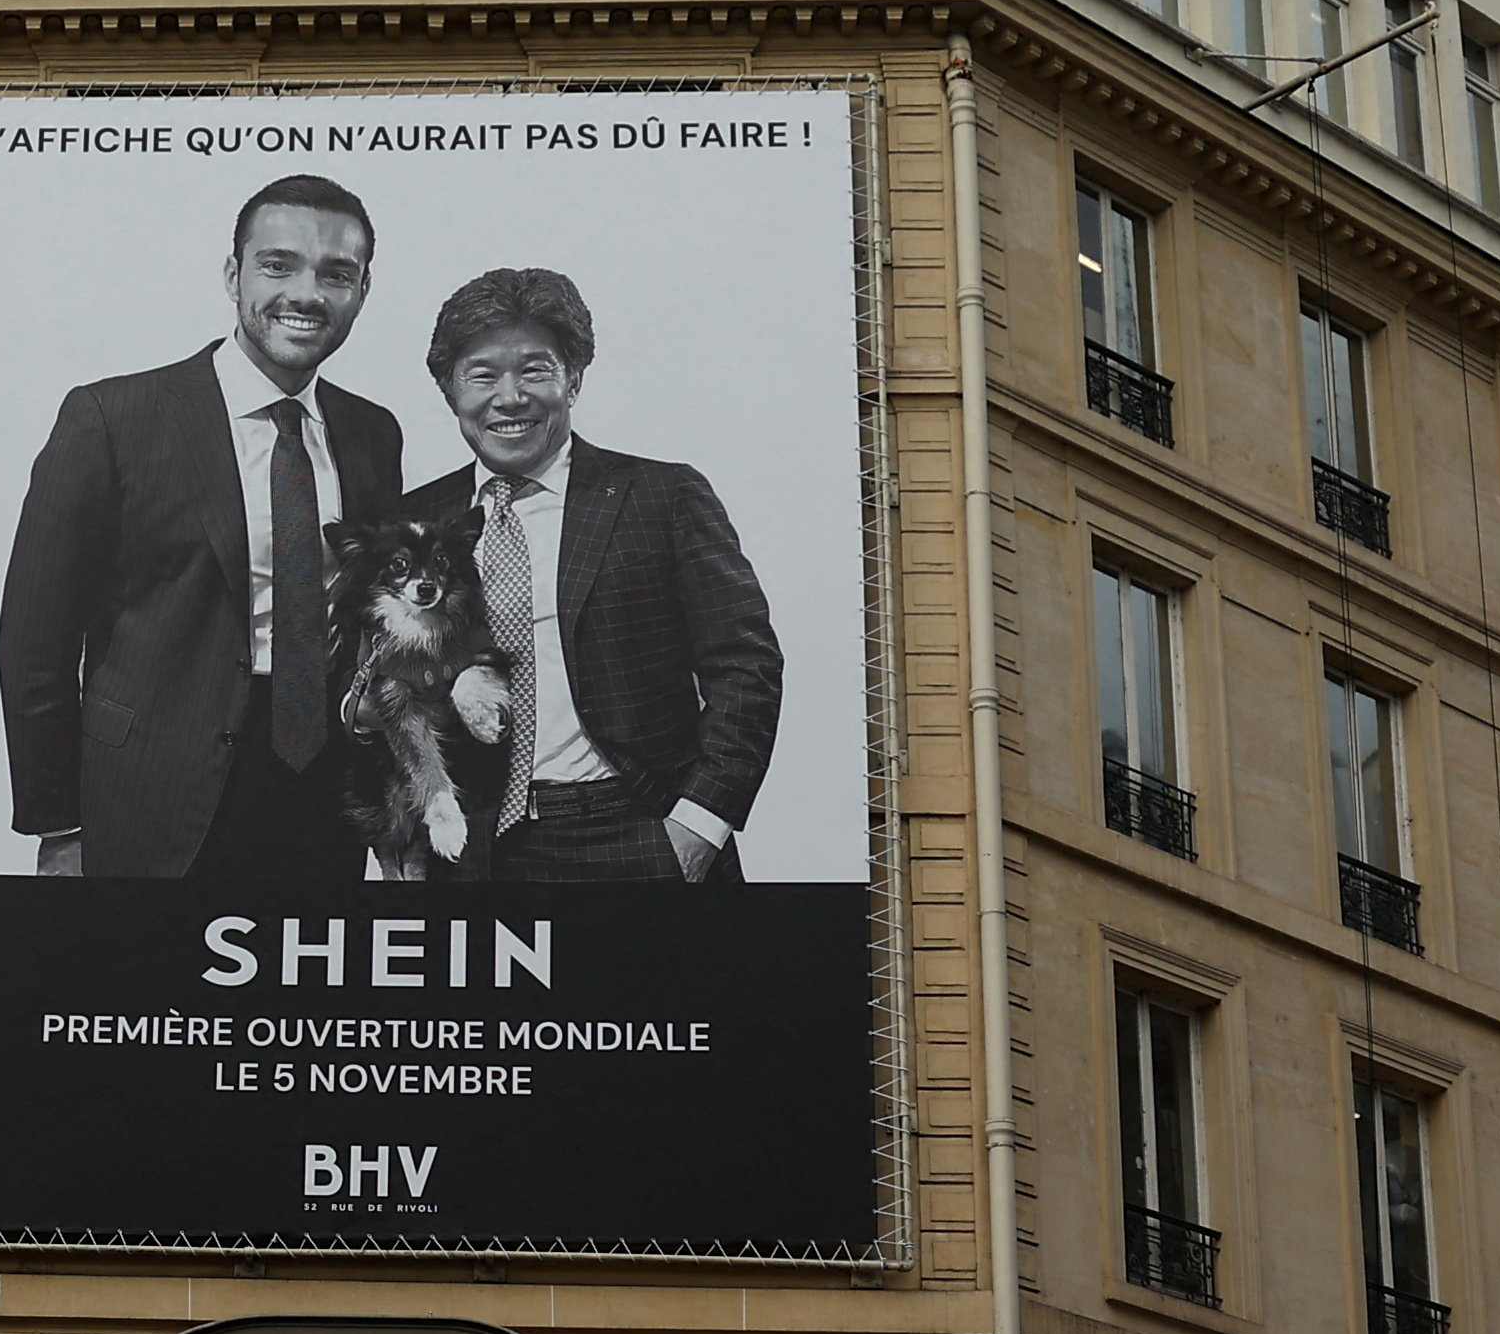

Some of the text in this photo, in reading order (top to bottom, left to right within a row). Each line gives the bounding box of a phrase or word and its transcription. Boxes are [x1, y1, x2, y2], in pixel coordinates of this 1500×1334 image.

[186, 126, 313, 156] QU’ON
[328, 124, 512, 152] N’AURAIT
[526, 123, 598, 150] PAS
[613, 116, 665, 149] DÛ
[680, 121, 788, 149] FAIRE
[201, 916, 551, 990] SHEIN
[42, 1008, 710, 1051] PREMIÈRE OUVERTURE MONDIALE
[215, 1062, 532, 1095] LE 5 NOVEMBRE
[304, 1144, 438, 1198] BHV
[331, 1203, 354, 1212] RUE
[367, 1203, 383, 1212] DE
[397, 1204, 438, 1213] RIVOLI
